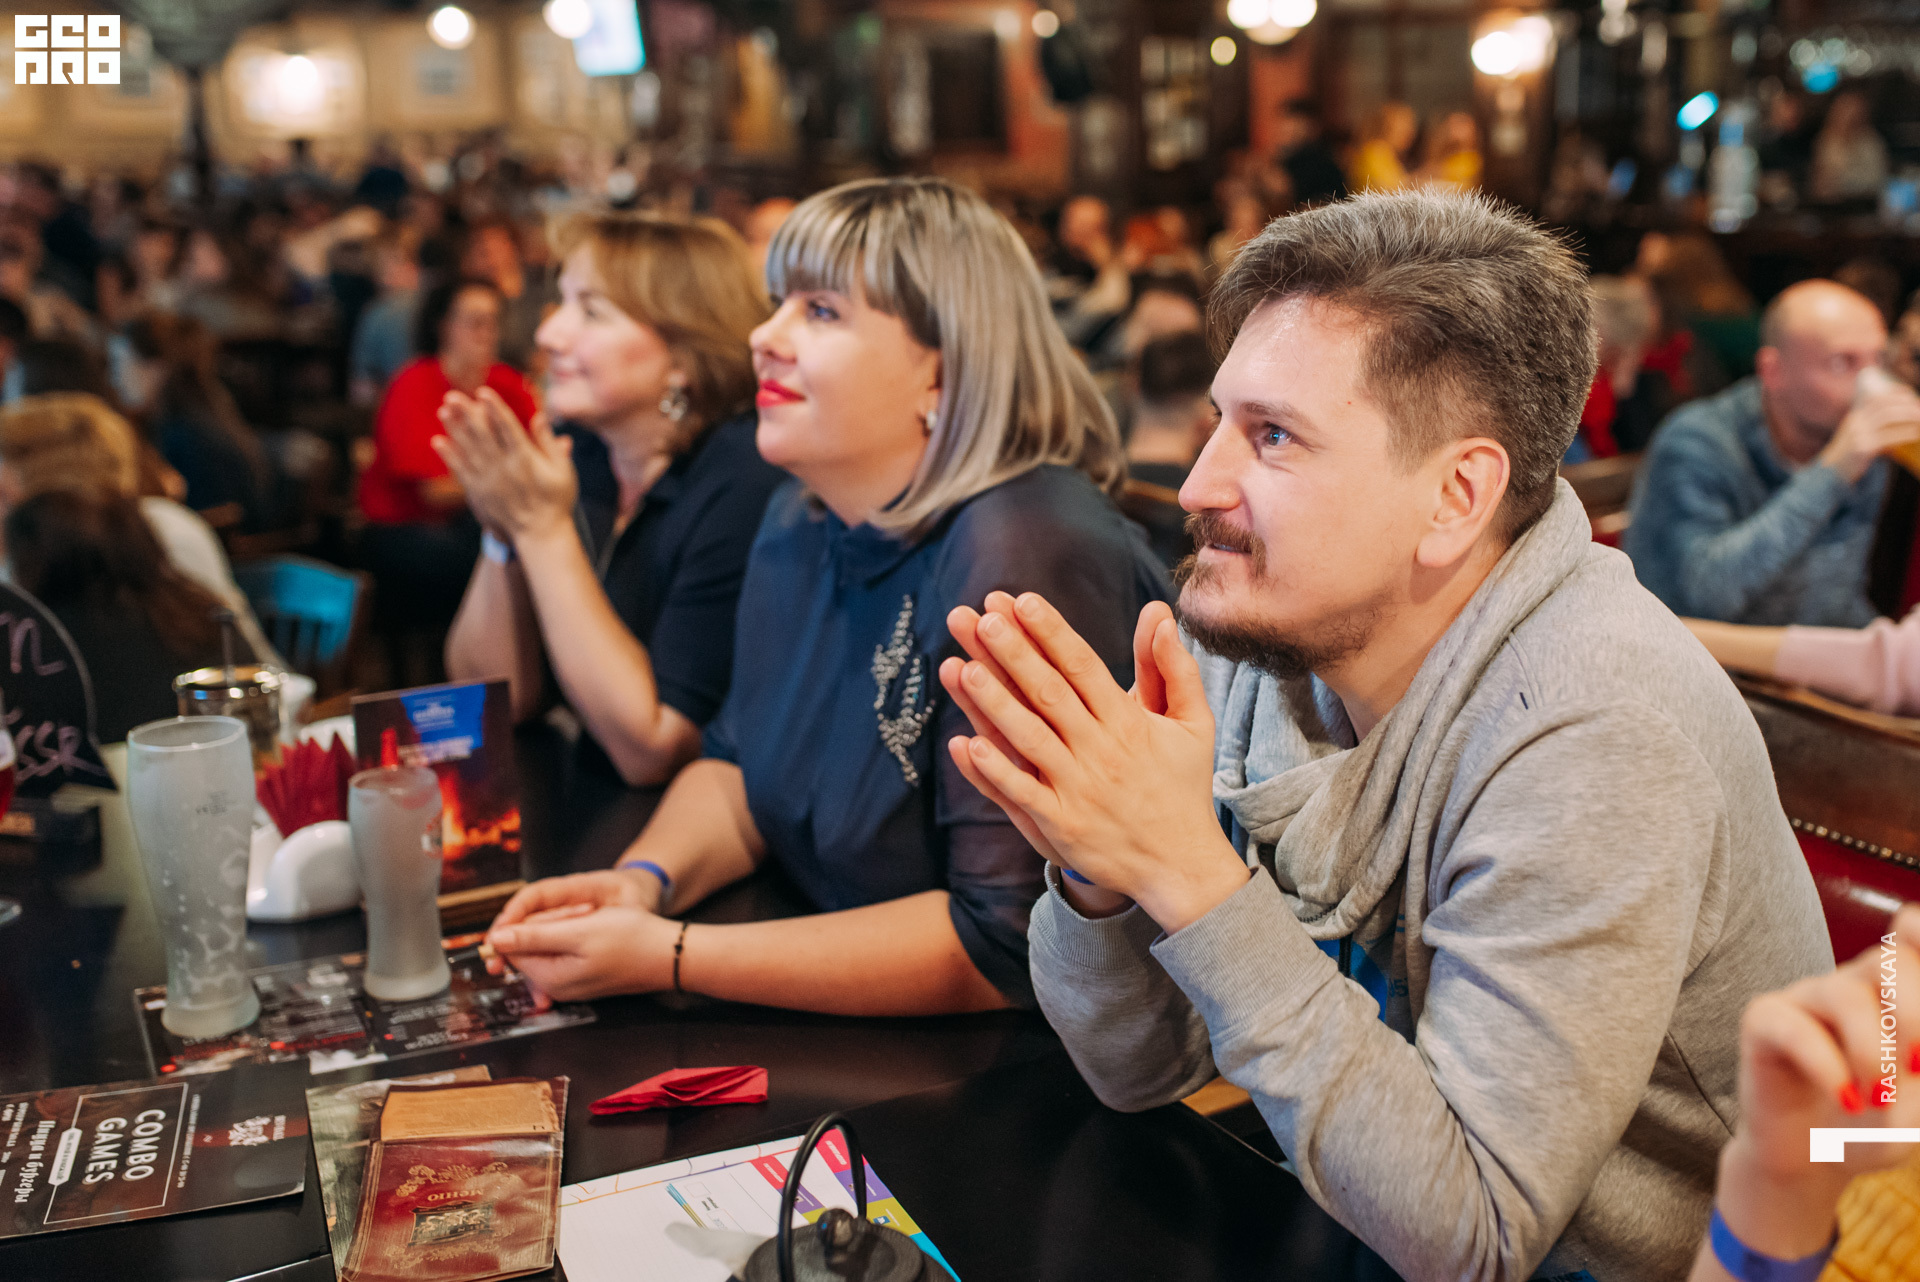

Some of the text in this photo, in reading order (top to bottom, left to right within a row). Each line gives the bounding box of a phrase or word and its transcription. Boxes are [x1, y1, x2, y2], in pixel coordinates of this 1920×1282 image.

[82, 1117, 128, 1185] GAMES
[122, 1109, 166, 1181] COMBO
[14, 1161, 44, 1204] бургеры
